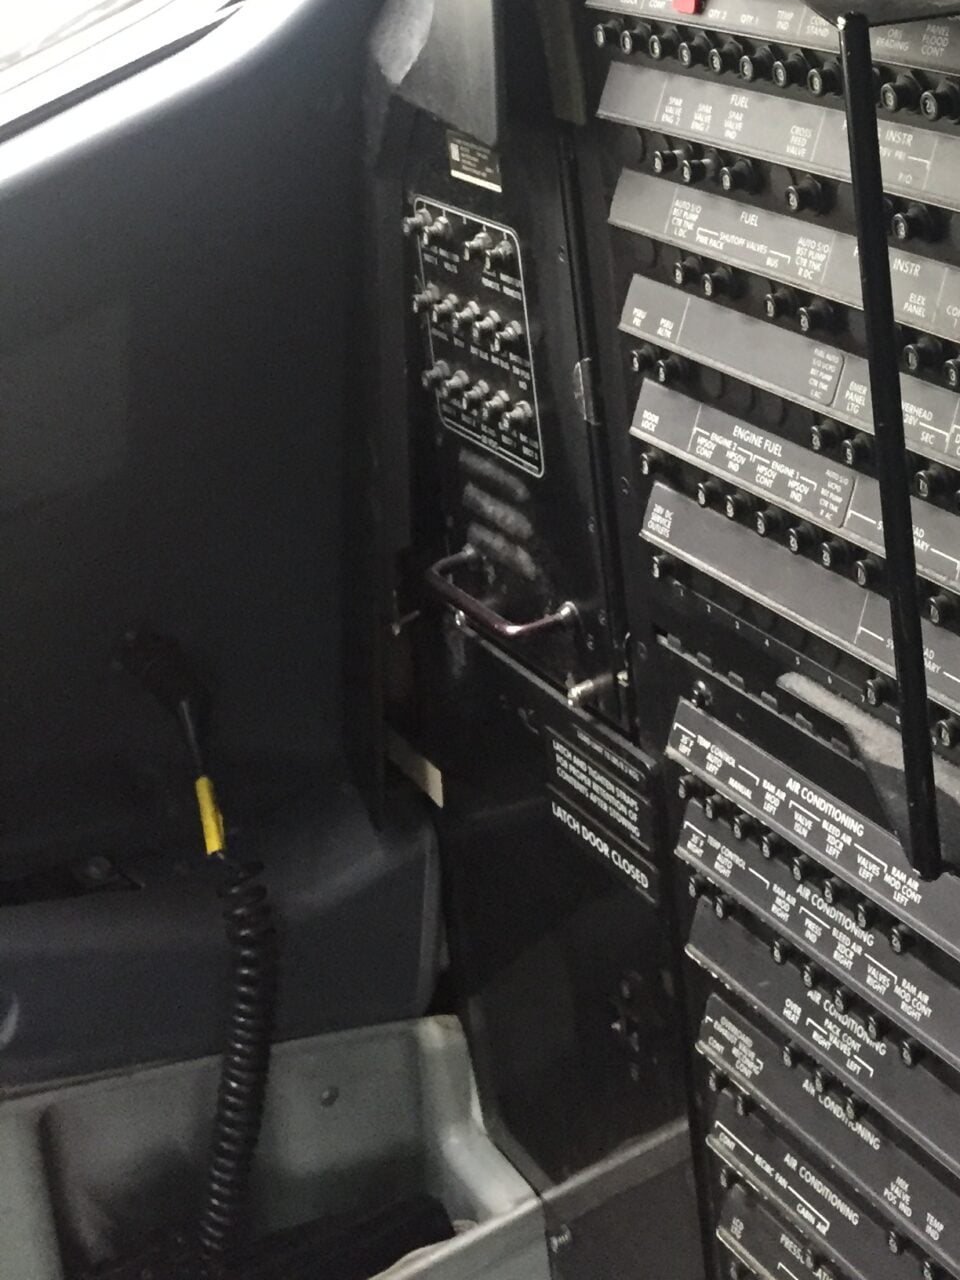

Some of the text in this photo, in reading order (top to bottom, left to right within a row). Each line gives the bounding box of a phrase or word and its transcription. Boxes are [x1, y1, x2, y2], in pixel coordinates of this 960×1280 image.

[733, 425, 782, 458] ENGINE FUEL
[786, 778, 865, 837] AIR CONDITIONING
[552, 801, 649, 888] LATCH DOOR CLOSED
[796, 884, 875, 946] AIR CONDITIONING
[884, 873, 922, 904] MOD CONT
[894, 985, 932, 1017] MOD CONT
[783, 1153, 860, 1226] AIR CONDITIONING
